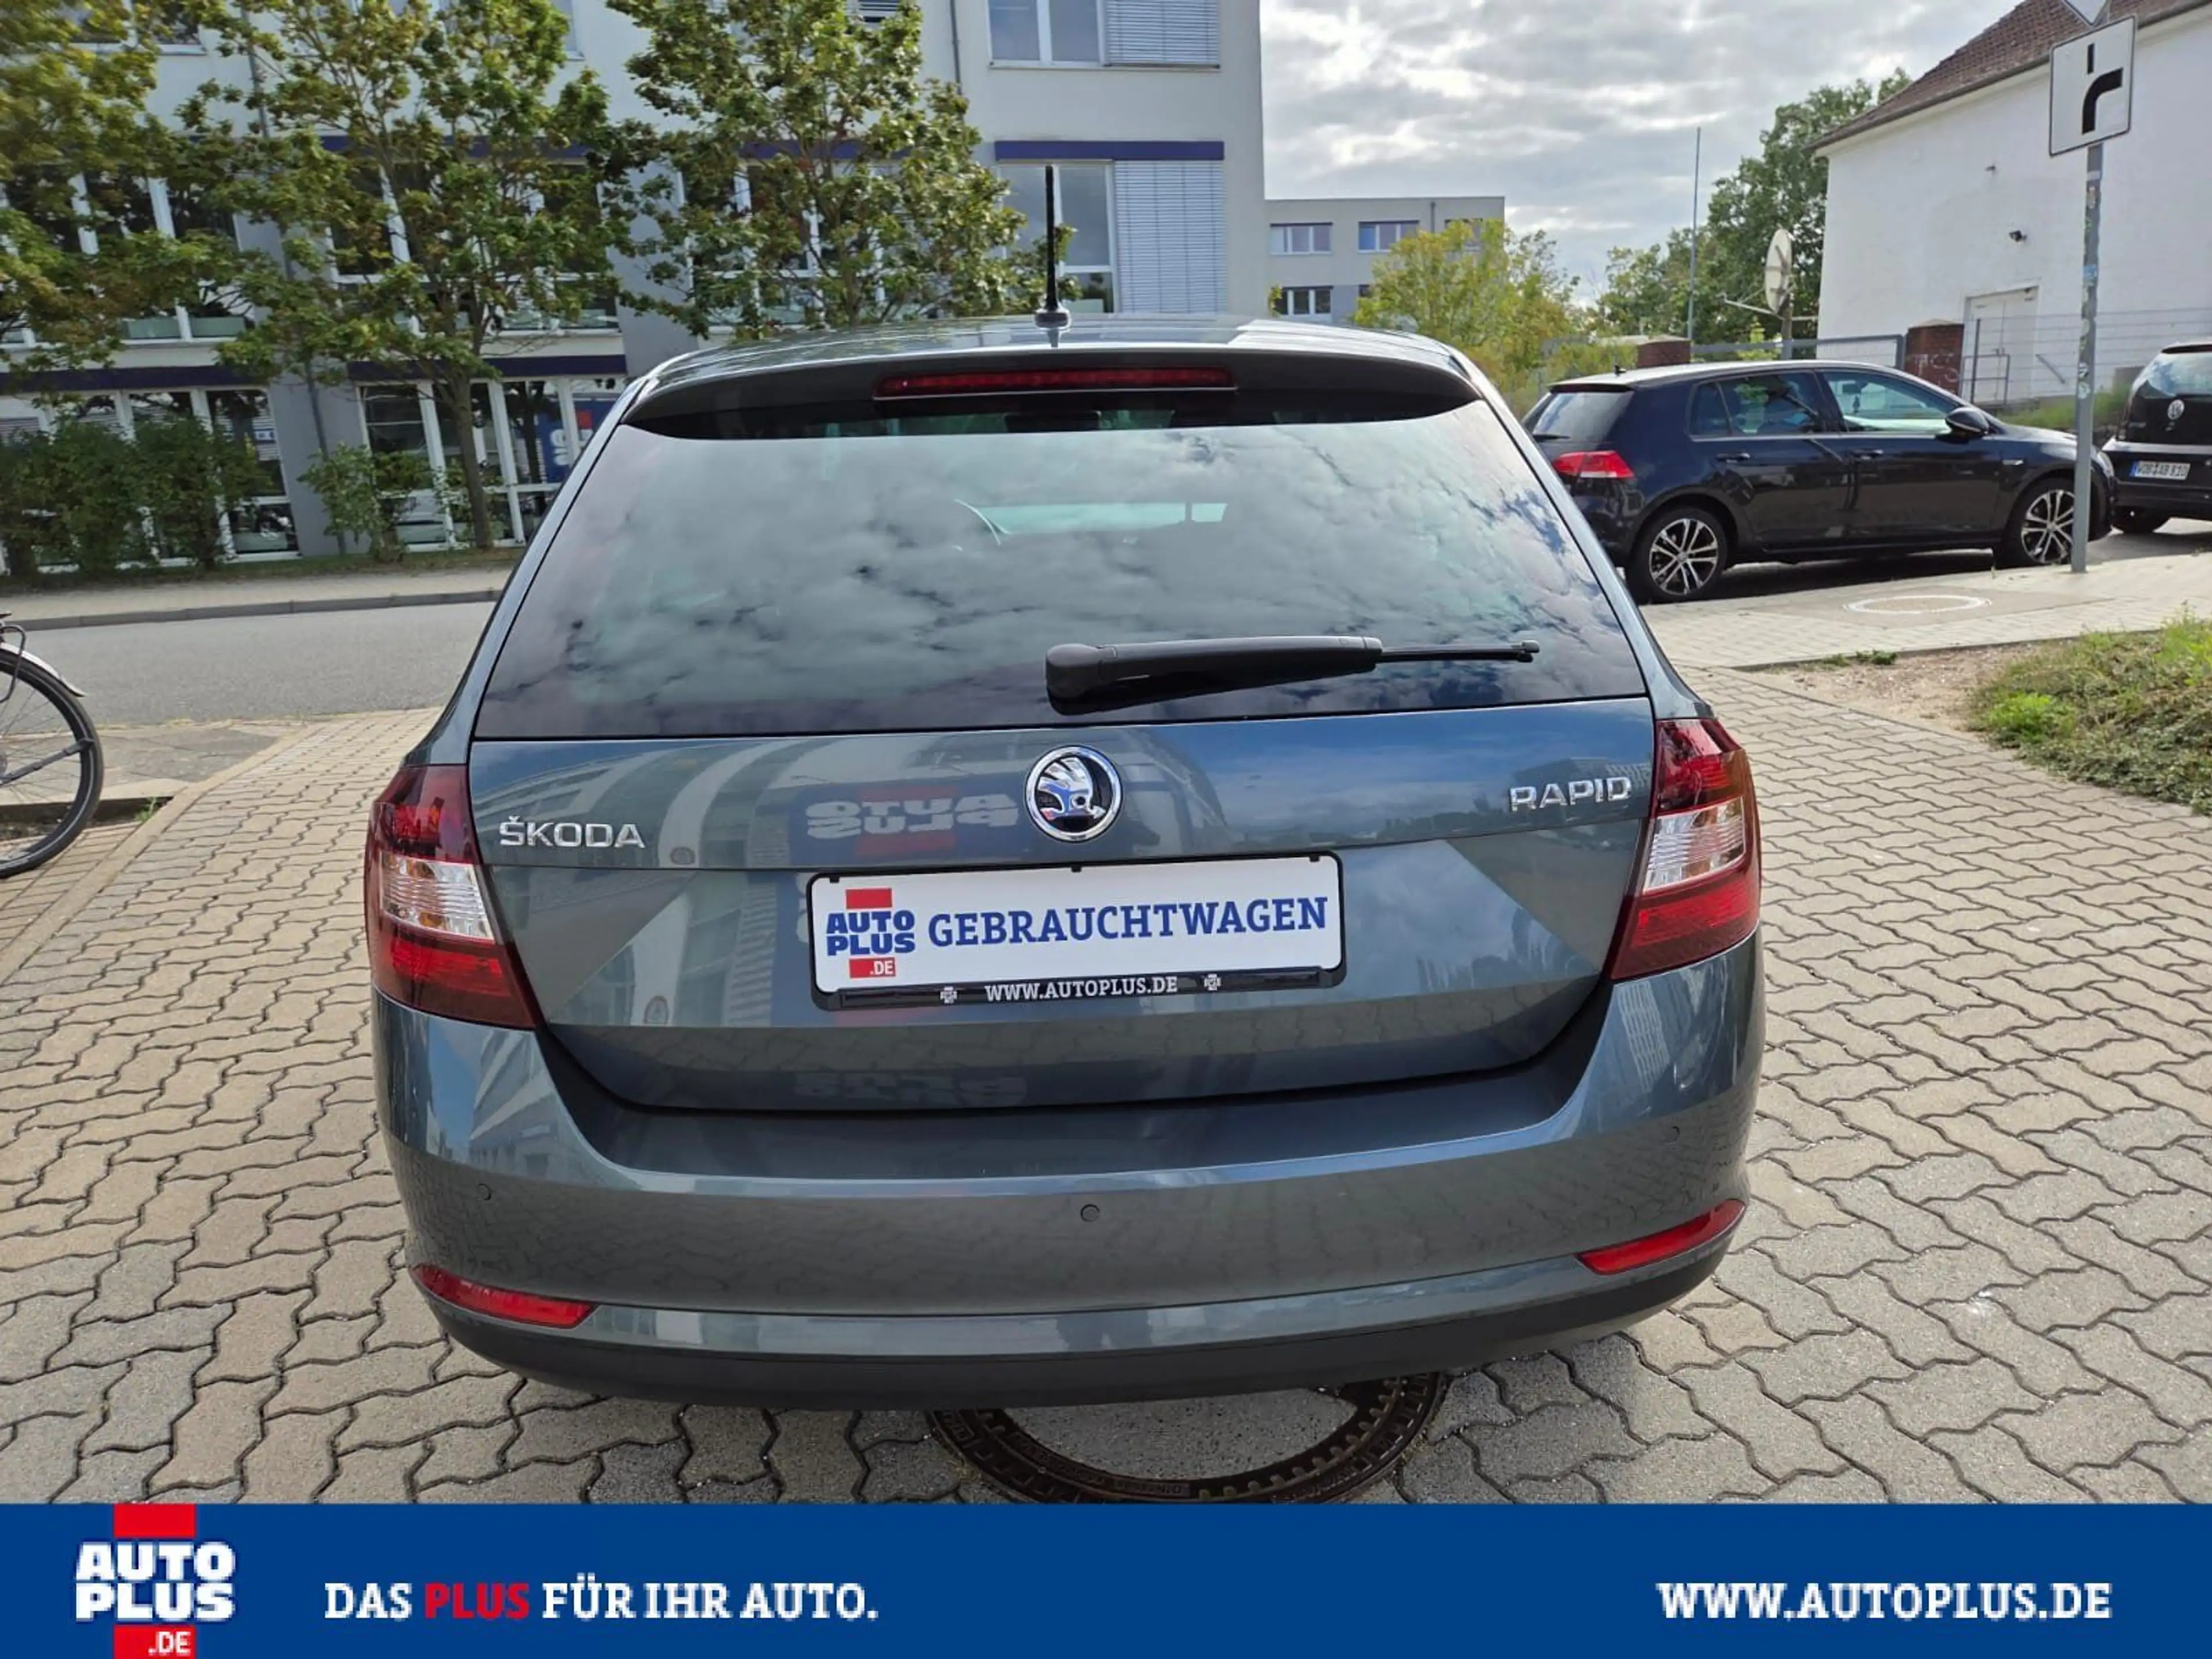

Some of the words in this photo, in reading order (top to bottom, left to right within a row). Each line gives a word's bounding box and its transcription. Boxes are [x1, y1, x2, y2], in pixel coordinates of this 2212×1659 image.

[1510, 776, 1632, 812] RAPID
[499, 815, 646, 849] ŠKODA
[827, 910, 915, 934] AUTO
[927, 897, 1328, 946] GEBRAUCHTWAGEN
[827, 932, 916, 956] PLUS
[870, 960, 894, 975] .DE
[984, 976, 1177, 1002] WWW.AUTOPLUS.DE
